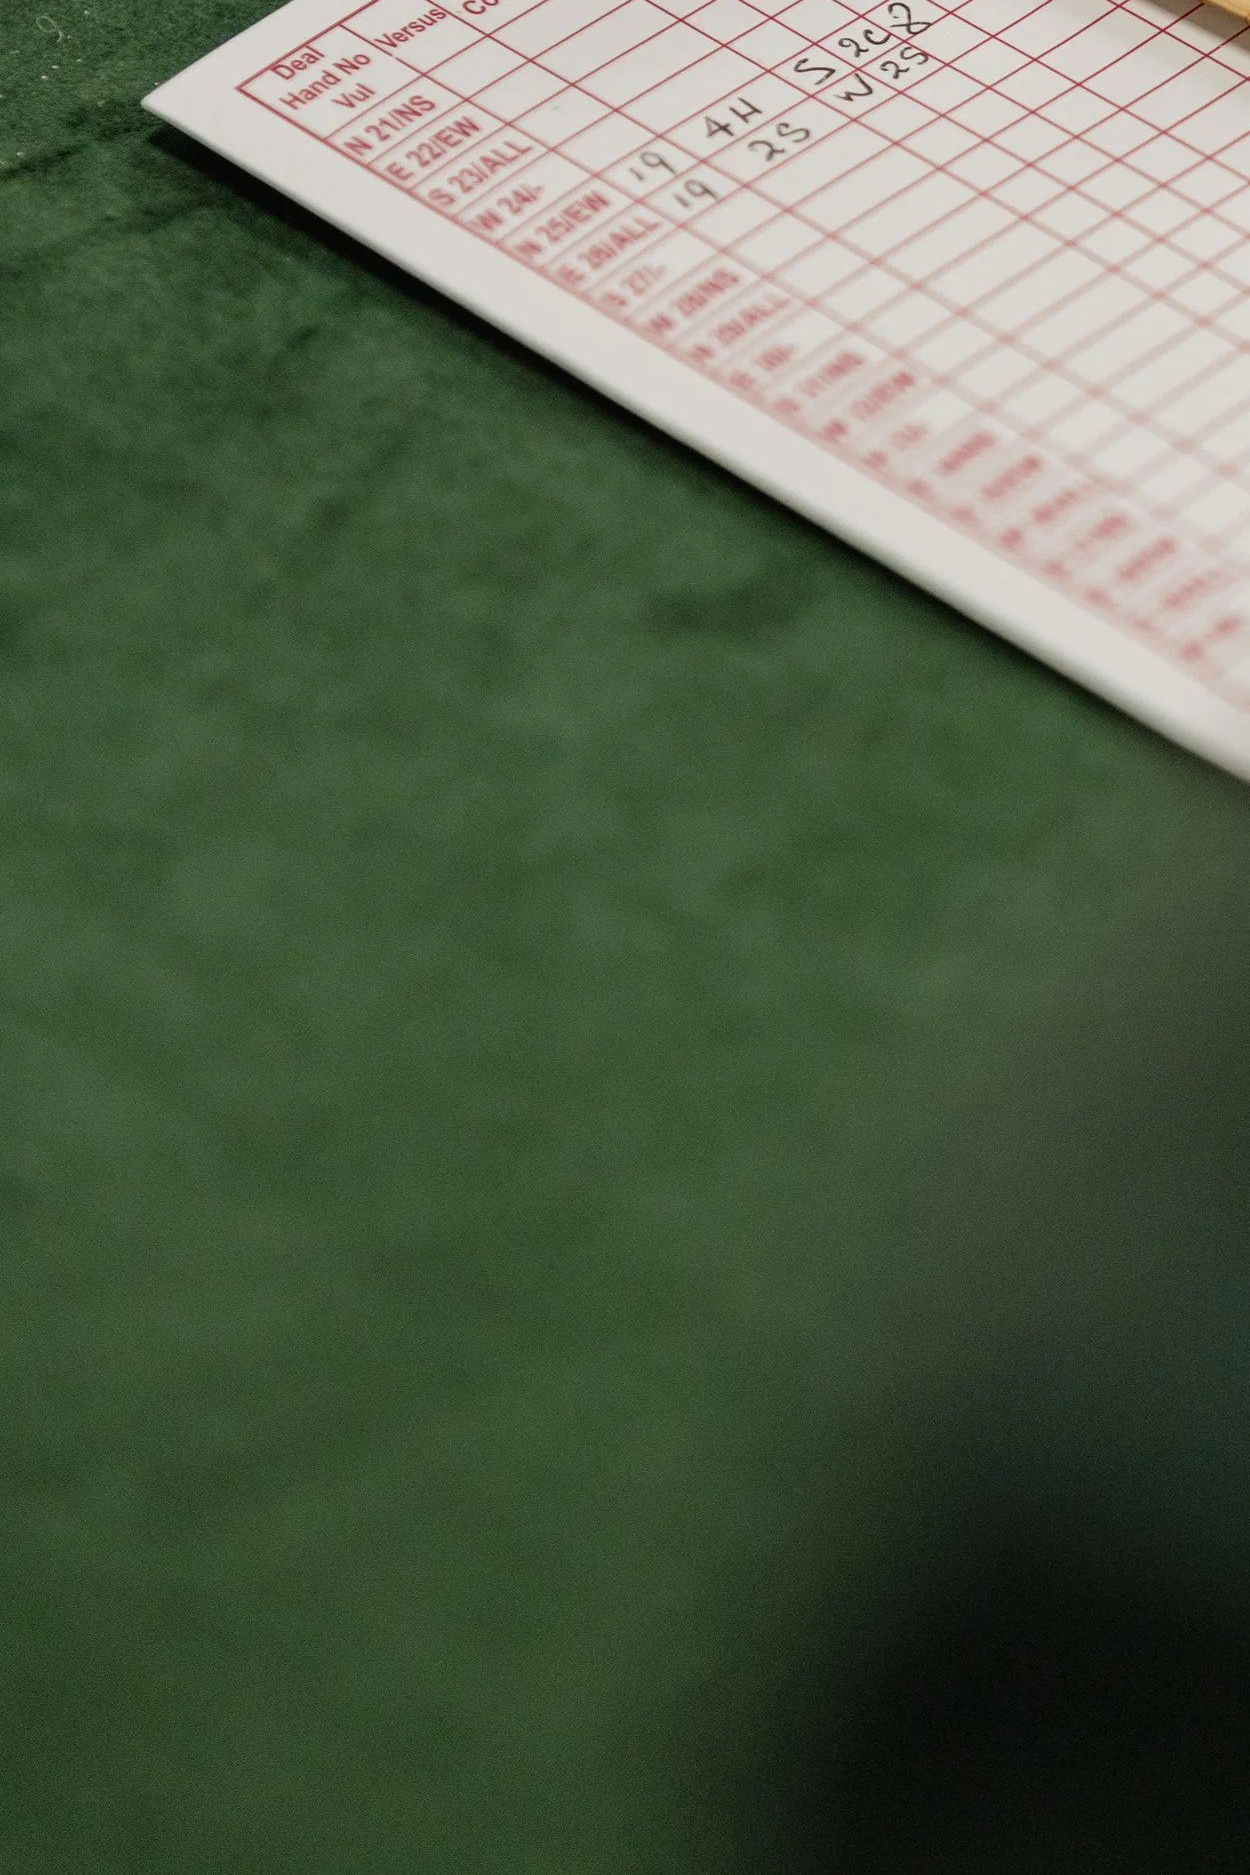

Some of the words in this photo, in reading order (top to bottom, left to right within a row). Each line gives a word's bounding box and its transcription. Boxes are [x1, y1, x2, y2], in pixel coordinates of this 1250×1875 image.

[373, 7, 448, 50] Versus
[269, 45, 326, 81] Deal
[279, 70, 341, 110] Hand
[332, 52, 371, 76] No
[331, 83, 376, 110] Vul
[344, 136, 373, 157] N
[364, 94, 436, 143] 21/NS
[405, 115, 483, 168] 22/EW
[448, 139, 533, 194] 23/ALL
